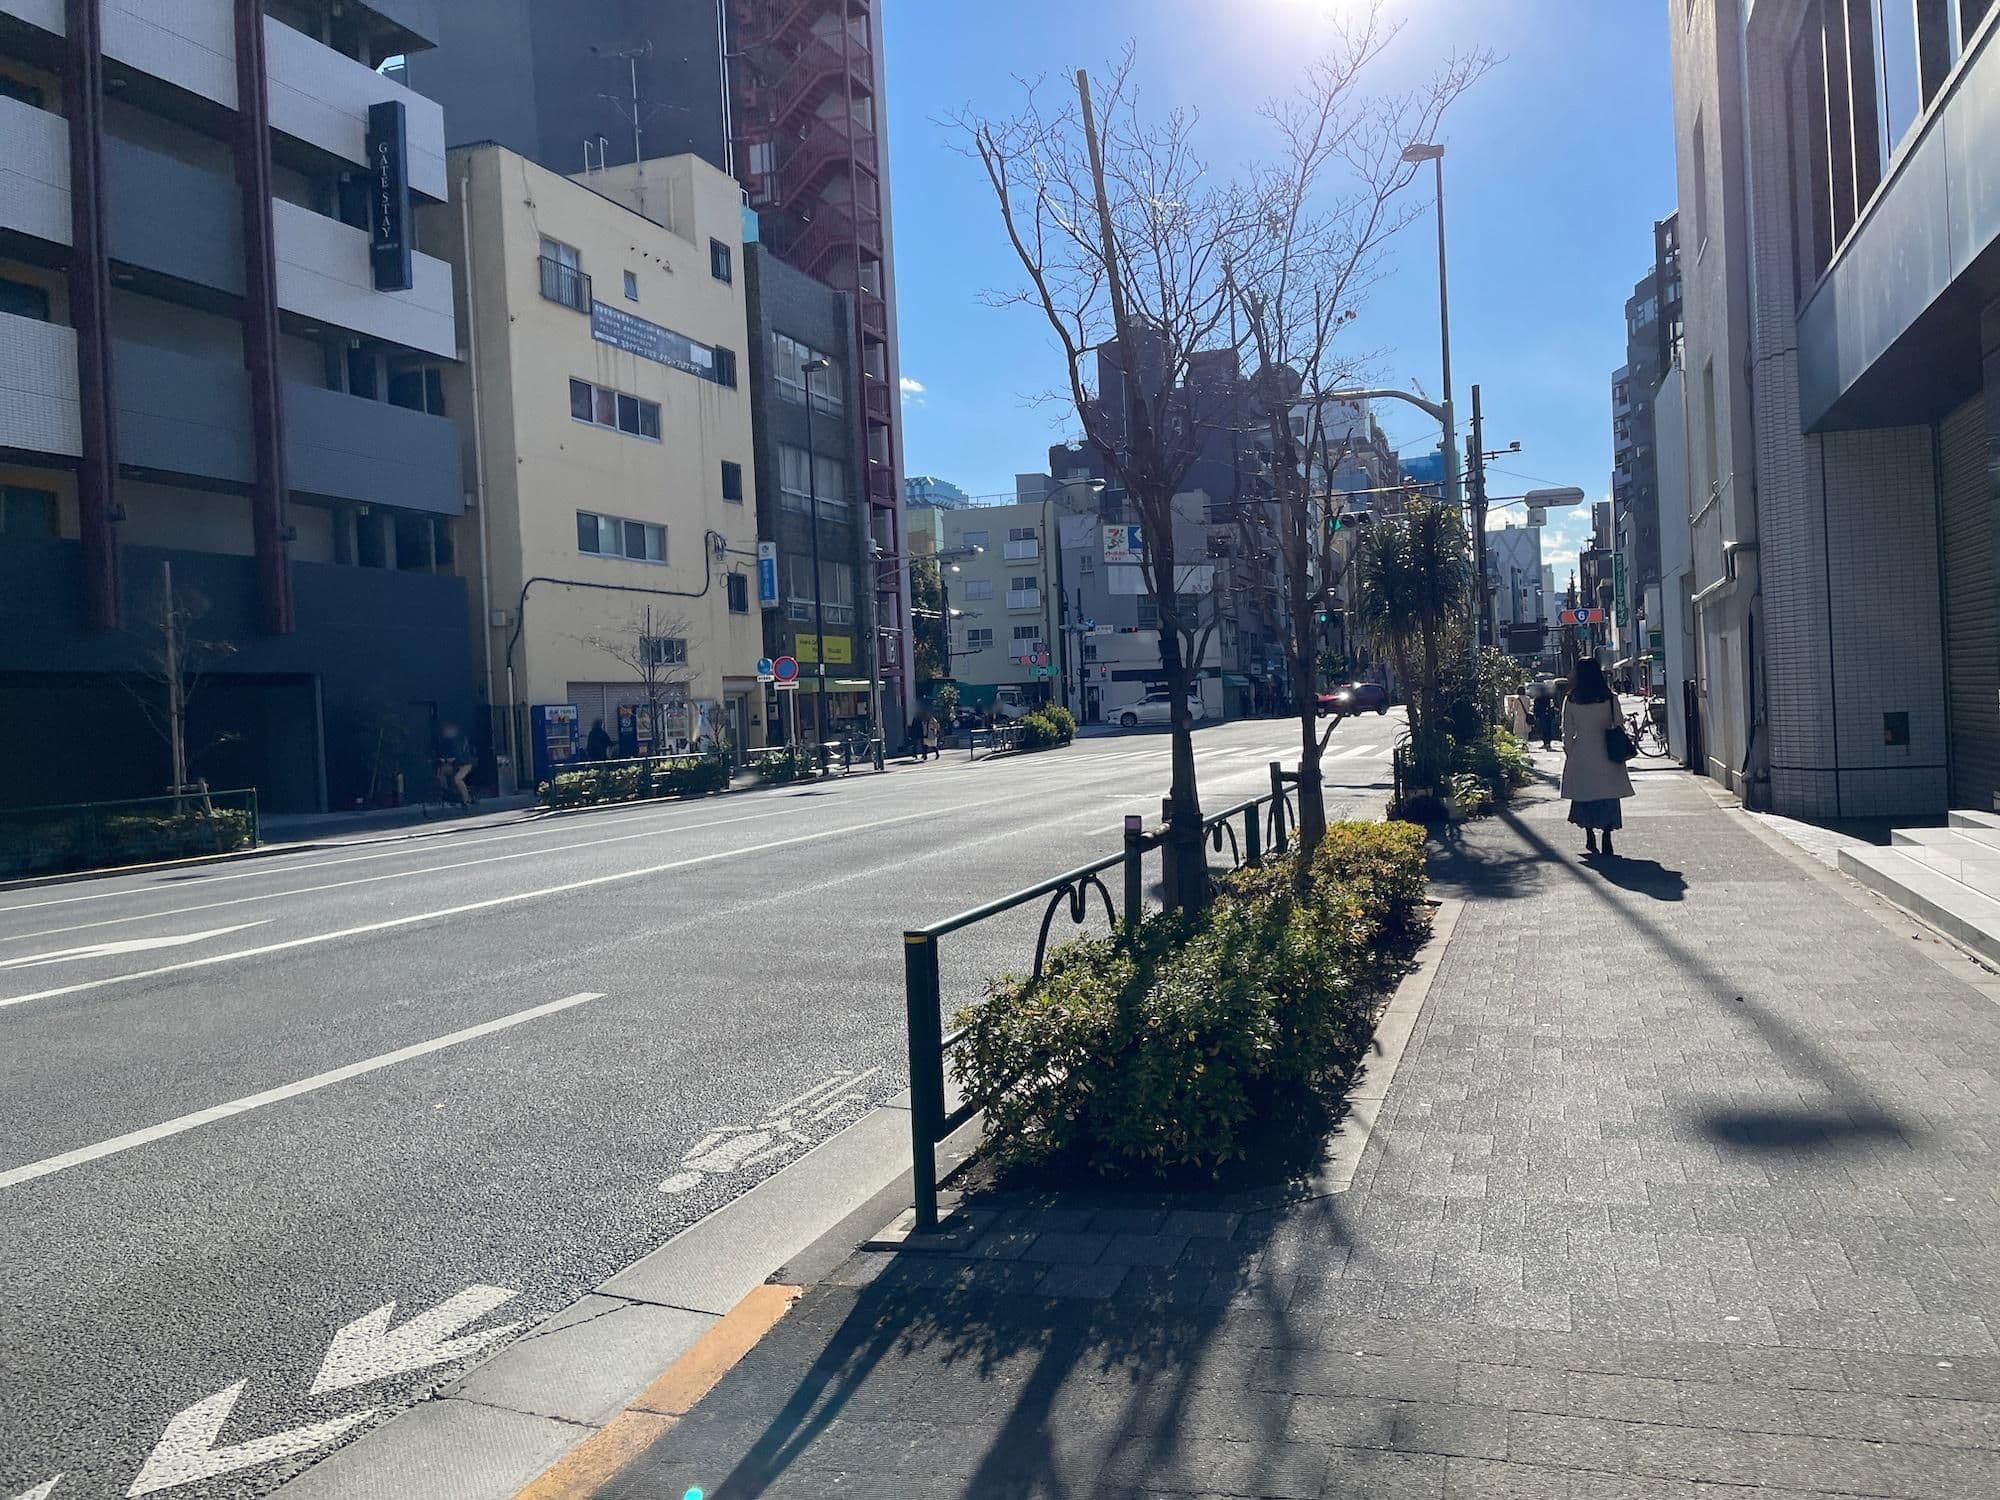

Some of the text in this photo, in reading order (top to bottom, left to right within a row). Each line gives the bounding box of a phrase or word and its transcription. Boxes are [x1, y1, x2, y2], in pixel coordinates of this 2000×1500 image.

[378, 142, 389, 188] GATE
[381, 192, 392, 238] STAY
[1578, 612, 1585, 621] 6
